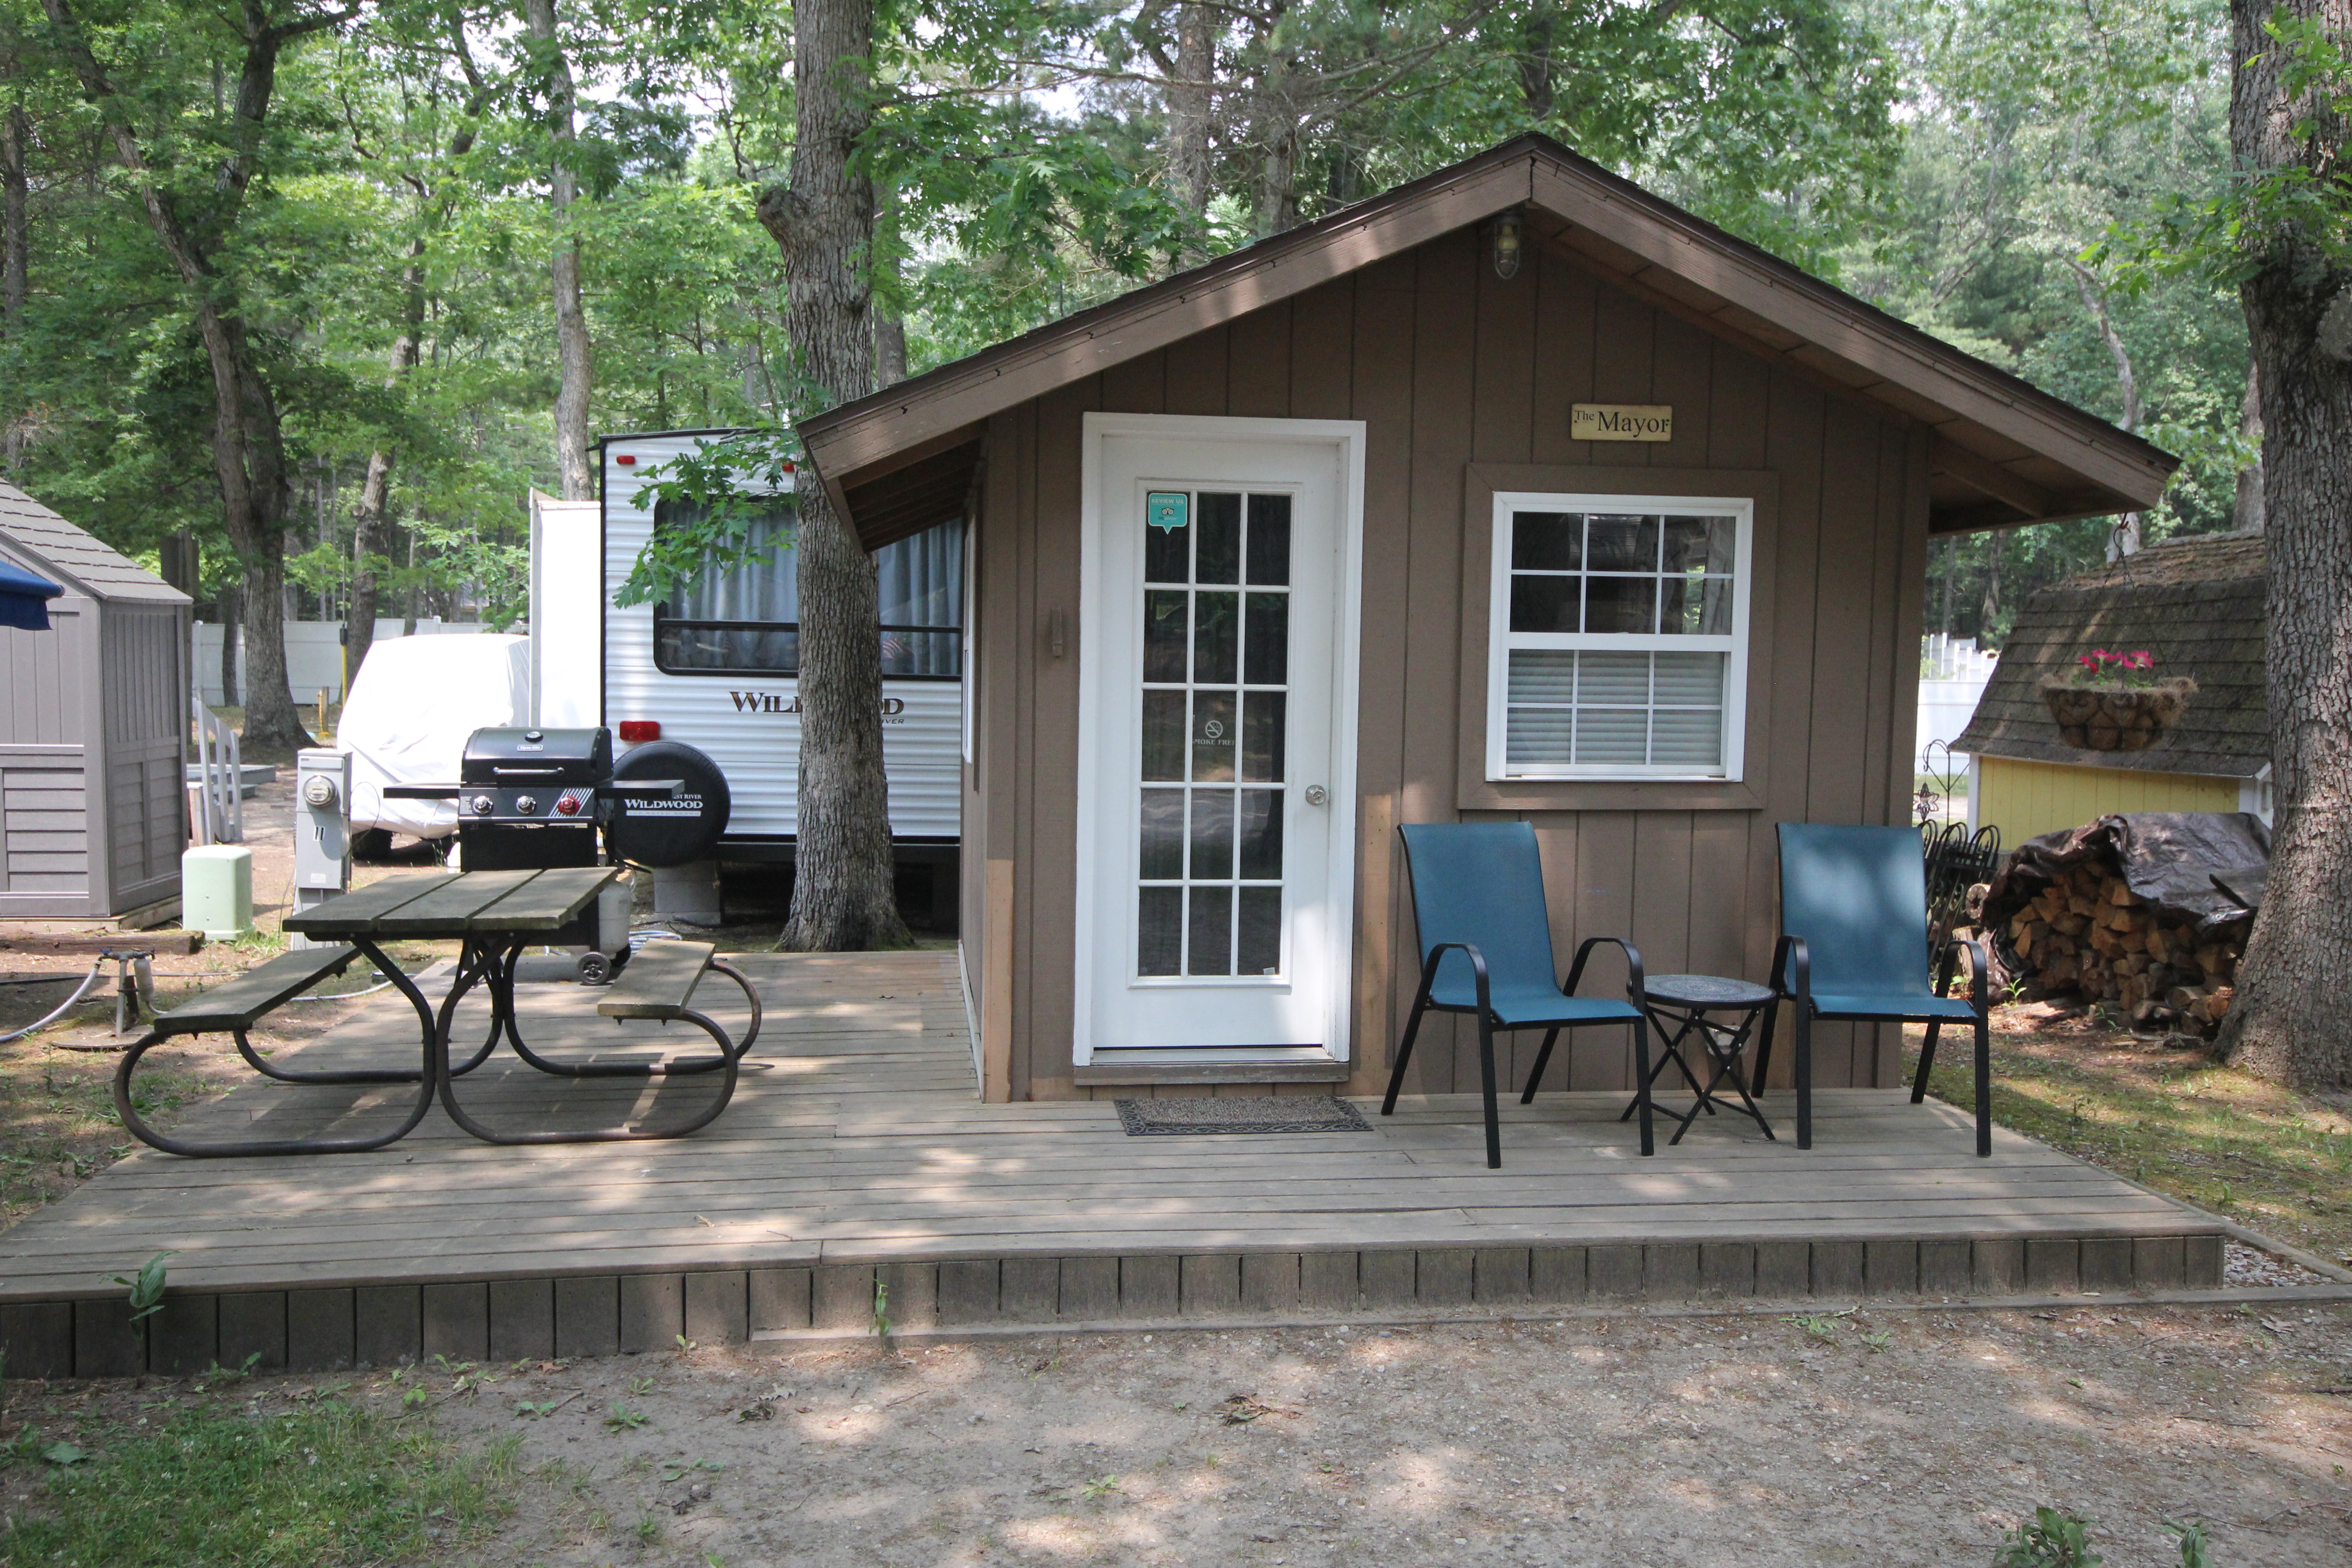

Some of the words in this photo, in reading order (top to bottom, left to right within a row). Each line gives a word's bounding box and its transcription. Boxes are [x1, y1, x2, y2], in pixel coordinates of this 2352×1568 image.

[1575, 410, 1594, 421] The
[1597, 411, 1670, 437] Mayor
[624, 799, 703, 808] WILDWOOD
